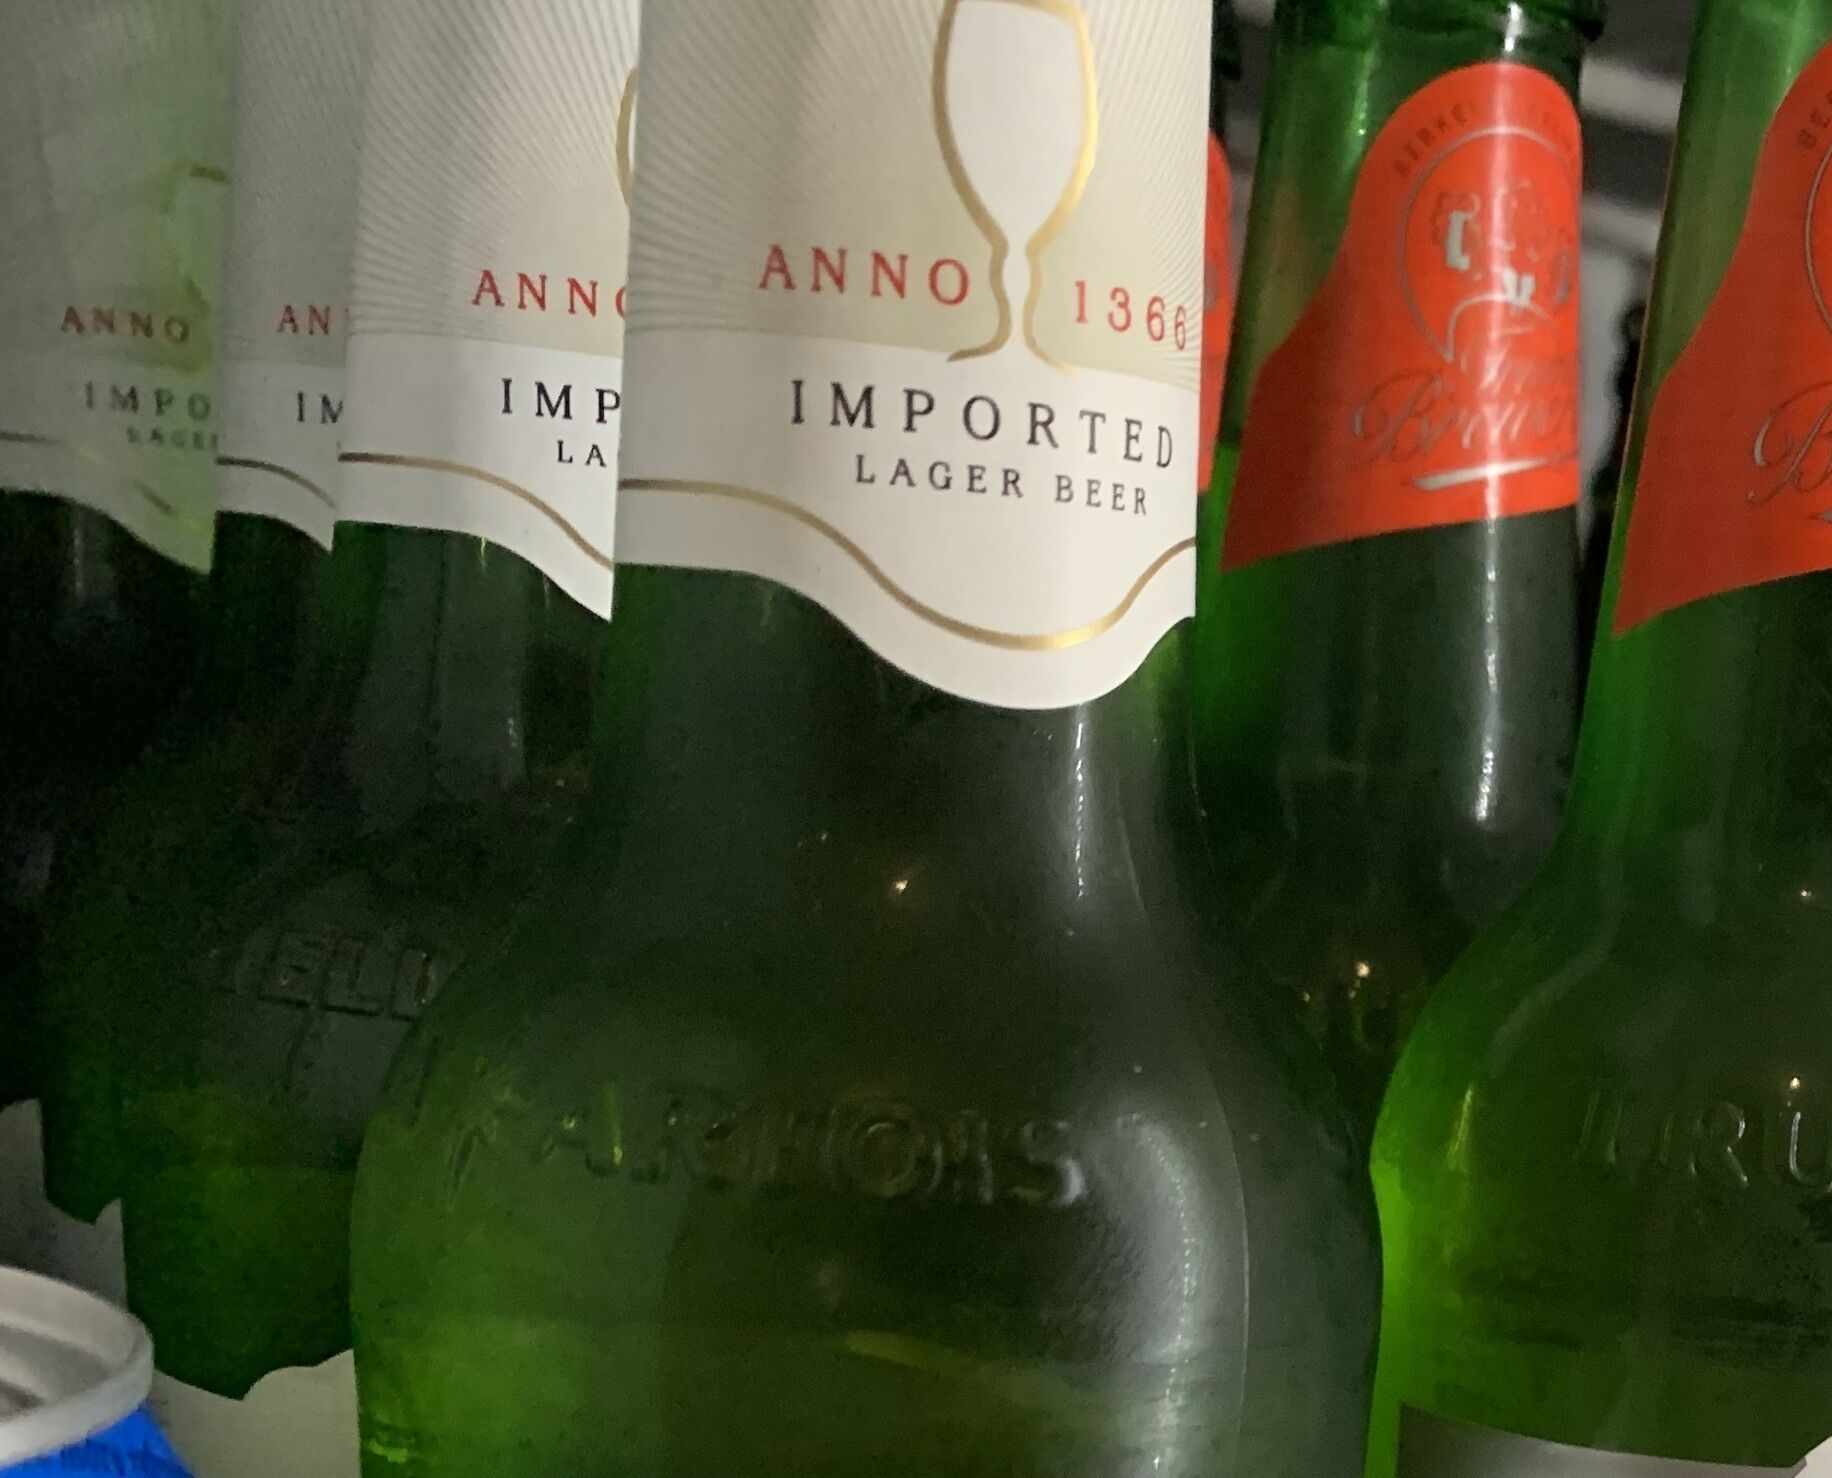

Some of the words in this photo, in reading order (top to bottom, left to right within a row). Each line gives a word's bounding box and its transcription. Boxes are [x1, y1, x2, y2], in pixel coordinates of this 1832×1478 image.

[758, 243, 970, 306] ANNO
[60, 303, 191, 345] ANNO
[1073, 279, 1188, 351] 1366
[789, 379, 1174, 470] IMPORTED
[855, 454, 1024, 499] LAGER
[1053, 474, 1149, 516] BEER
